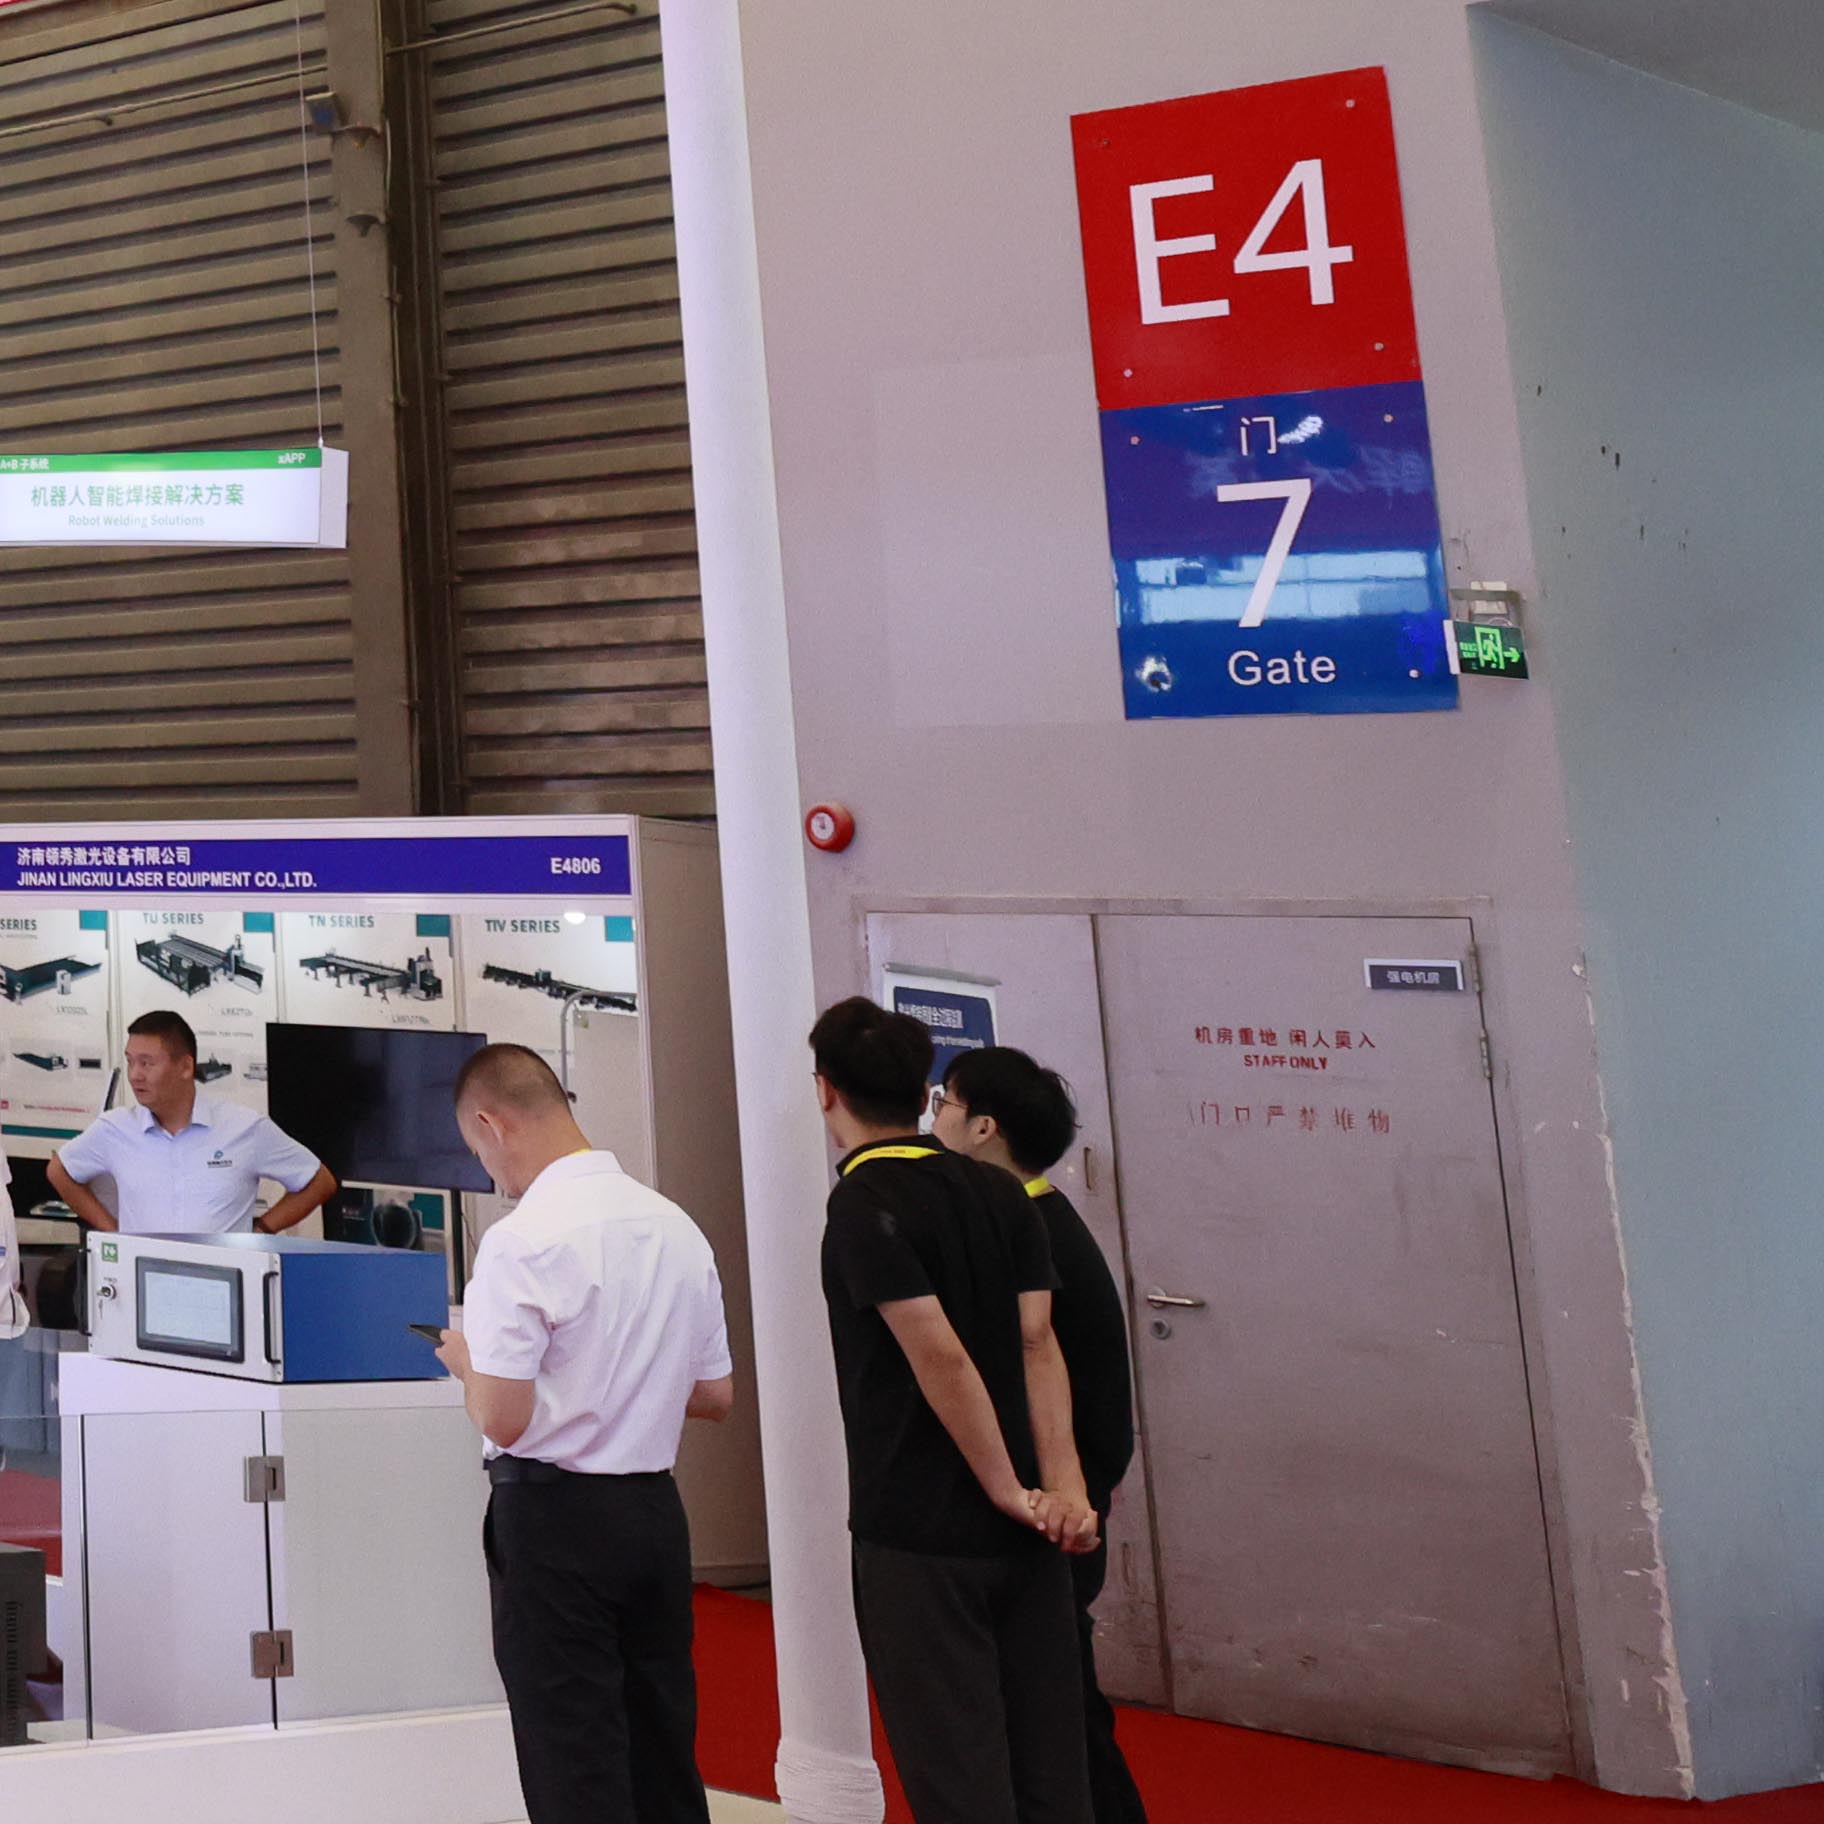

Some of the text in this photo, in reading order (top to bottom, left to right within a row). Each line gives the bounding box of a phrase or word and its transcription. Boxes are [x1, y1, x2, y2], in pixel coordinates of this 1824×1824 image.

[1128, 158, 1354, 325] E4
[1240, 416, 1278, 456] 门
[31, 483, 245, 508] 机器人智能焊接解决方案
[68, 514, 205, 529] Robot Welding Solutions
[1216, 478, 1312, 628] 7
[1227, 650, 1337, 686] Gate
[17, 847, 191, 867] 济南领秀激光设备有限公司
[550, 857, 601, 875] E4806
[17, 871, 56, 887] JINAN
[58, 871, 113, 887] LINGXIU
[116, 871, 163, 887] LASER
[167, 871, 251, 887] EQUIPMENT
[0, 918, 37, 931] SERIES
[162, 913, 204, 925] SERIES
[330, 914, 375, 928] SERIES
[511, 920, 561, 934] SERIES
[1194, 1026, 1377, 1051] 机房重地 闲人莫入
[1243, 1054, 1328, 1071] STAFF ONLY
